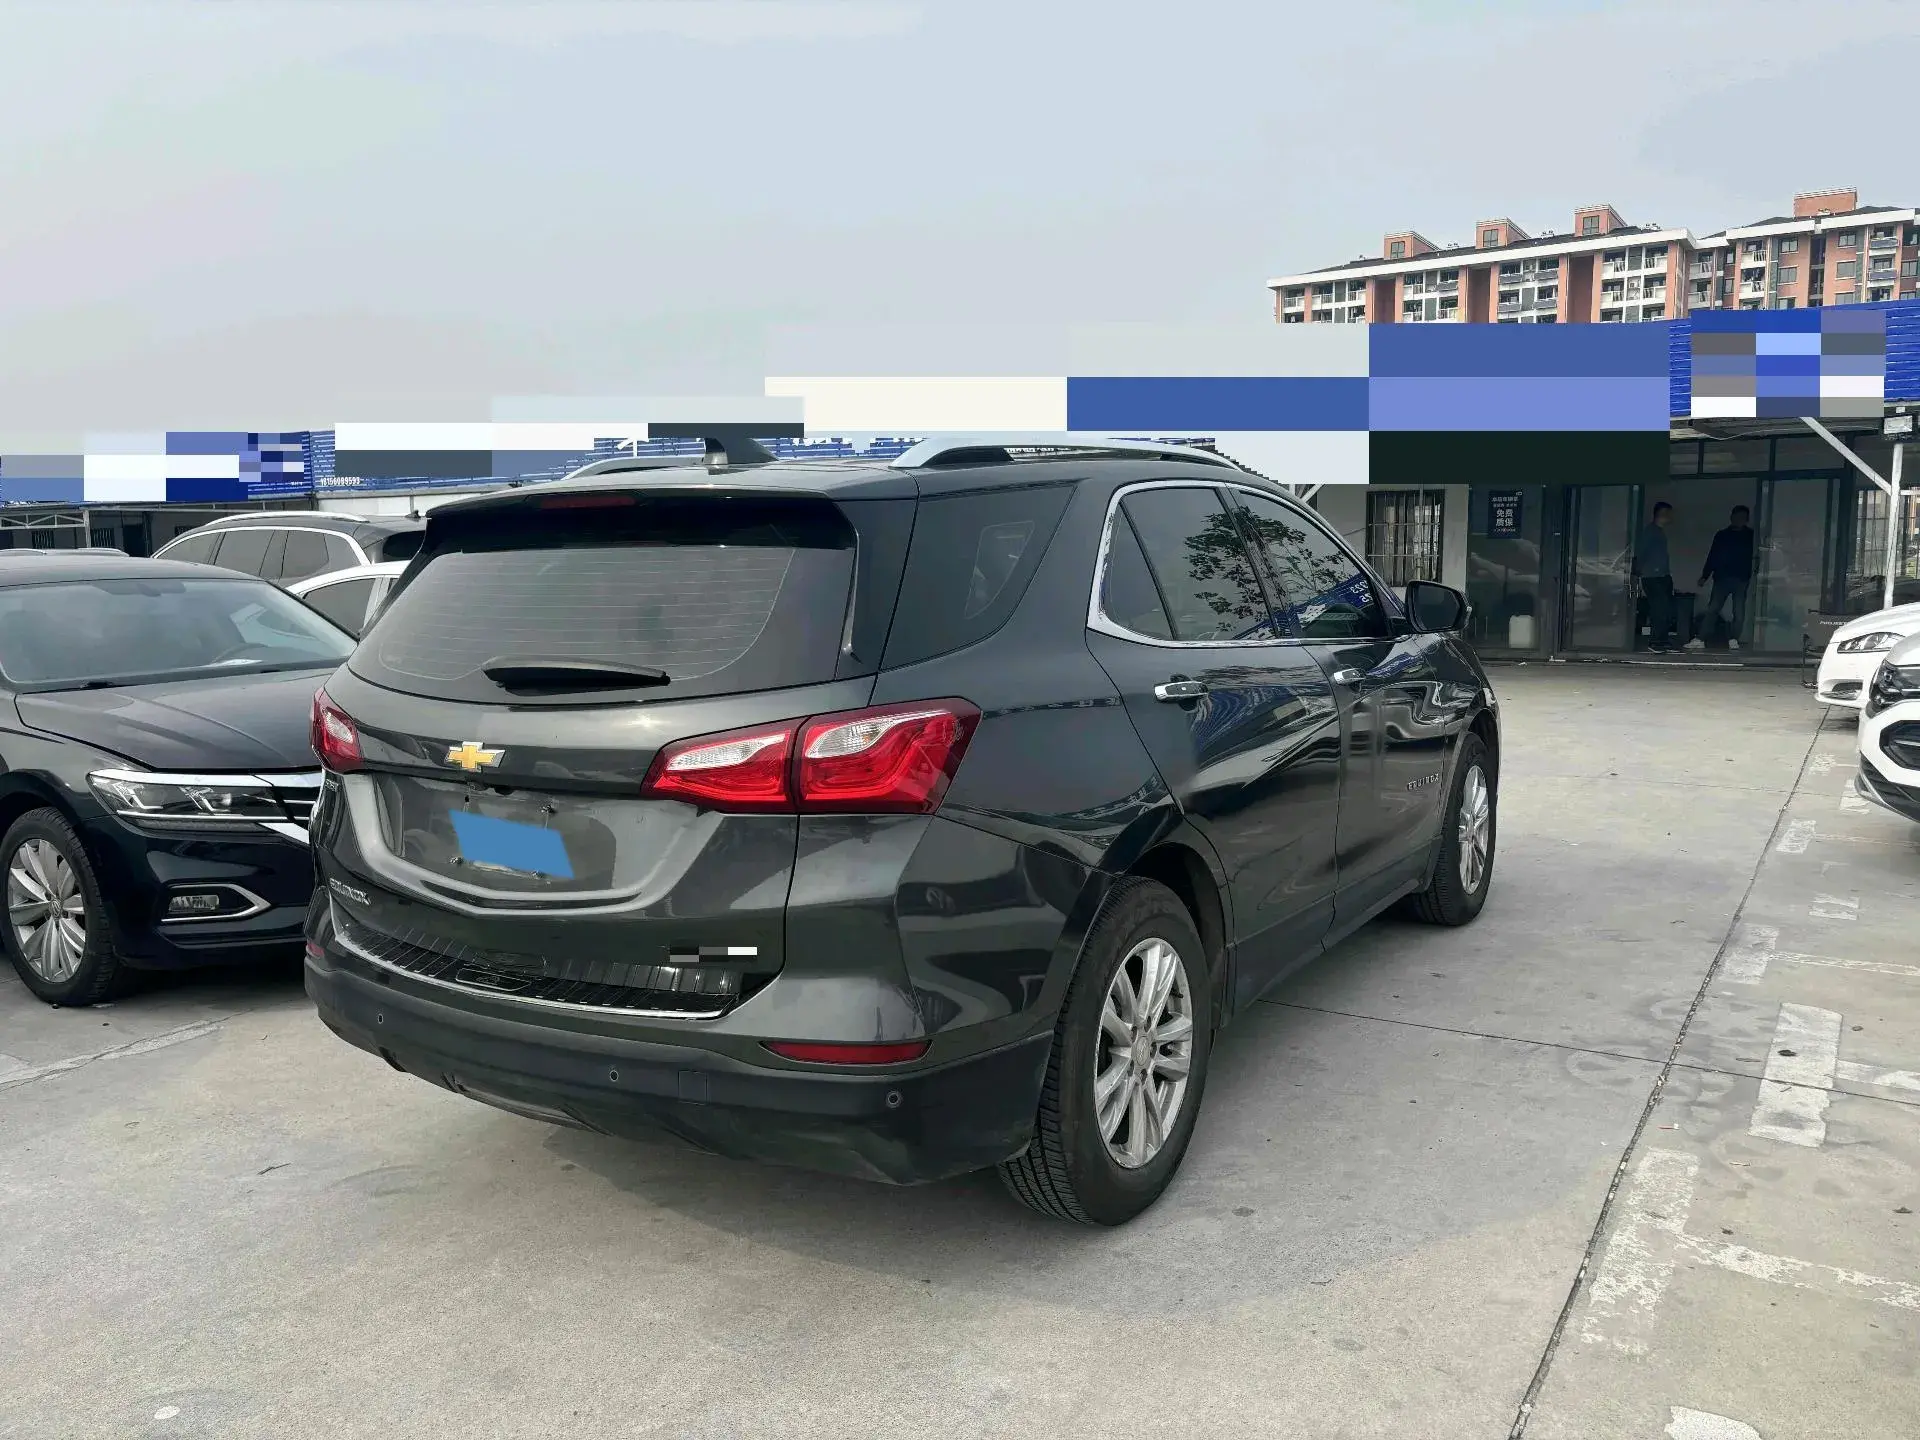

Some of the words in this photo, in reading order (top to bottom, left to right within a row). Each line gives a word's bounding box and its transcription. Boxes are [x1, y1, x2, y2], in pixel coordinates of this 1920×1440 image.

[1496, 509, 1513, 517] 免费
[1496, 518, 1513, 526] 质保
[1408, 773, 1439, 790] EQUINOX
